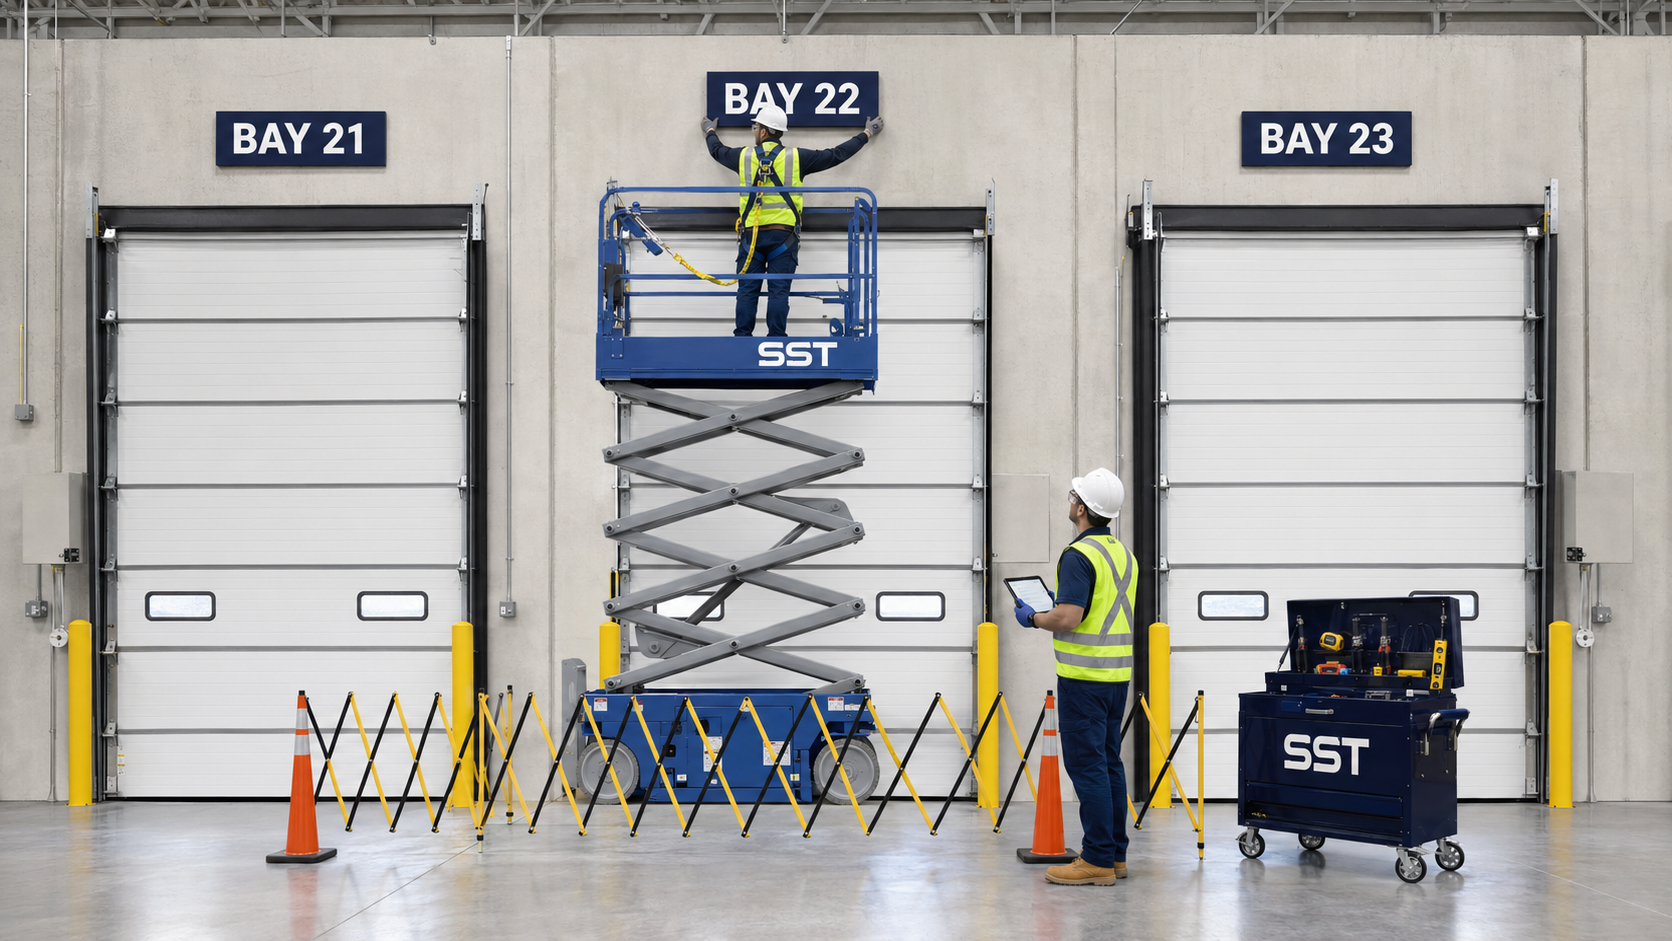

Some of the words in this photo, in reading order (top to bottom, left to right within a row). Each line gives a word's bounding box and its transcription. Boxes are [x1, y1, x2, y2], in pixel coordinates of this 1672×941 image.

[725, 82, 804, 115] BAY
[814, 82, 860, 115] 22
[233, 122, 312, 155] BAY
[322, 122, 364, 155] 21
[1260, 122, 1338, 155] BAY
[1348, 122, 1394, 155] 23
[757, 341, 838, 367] SST
[1283, 733, 1371, 776] SST
